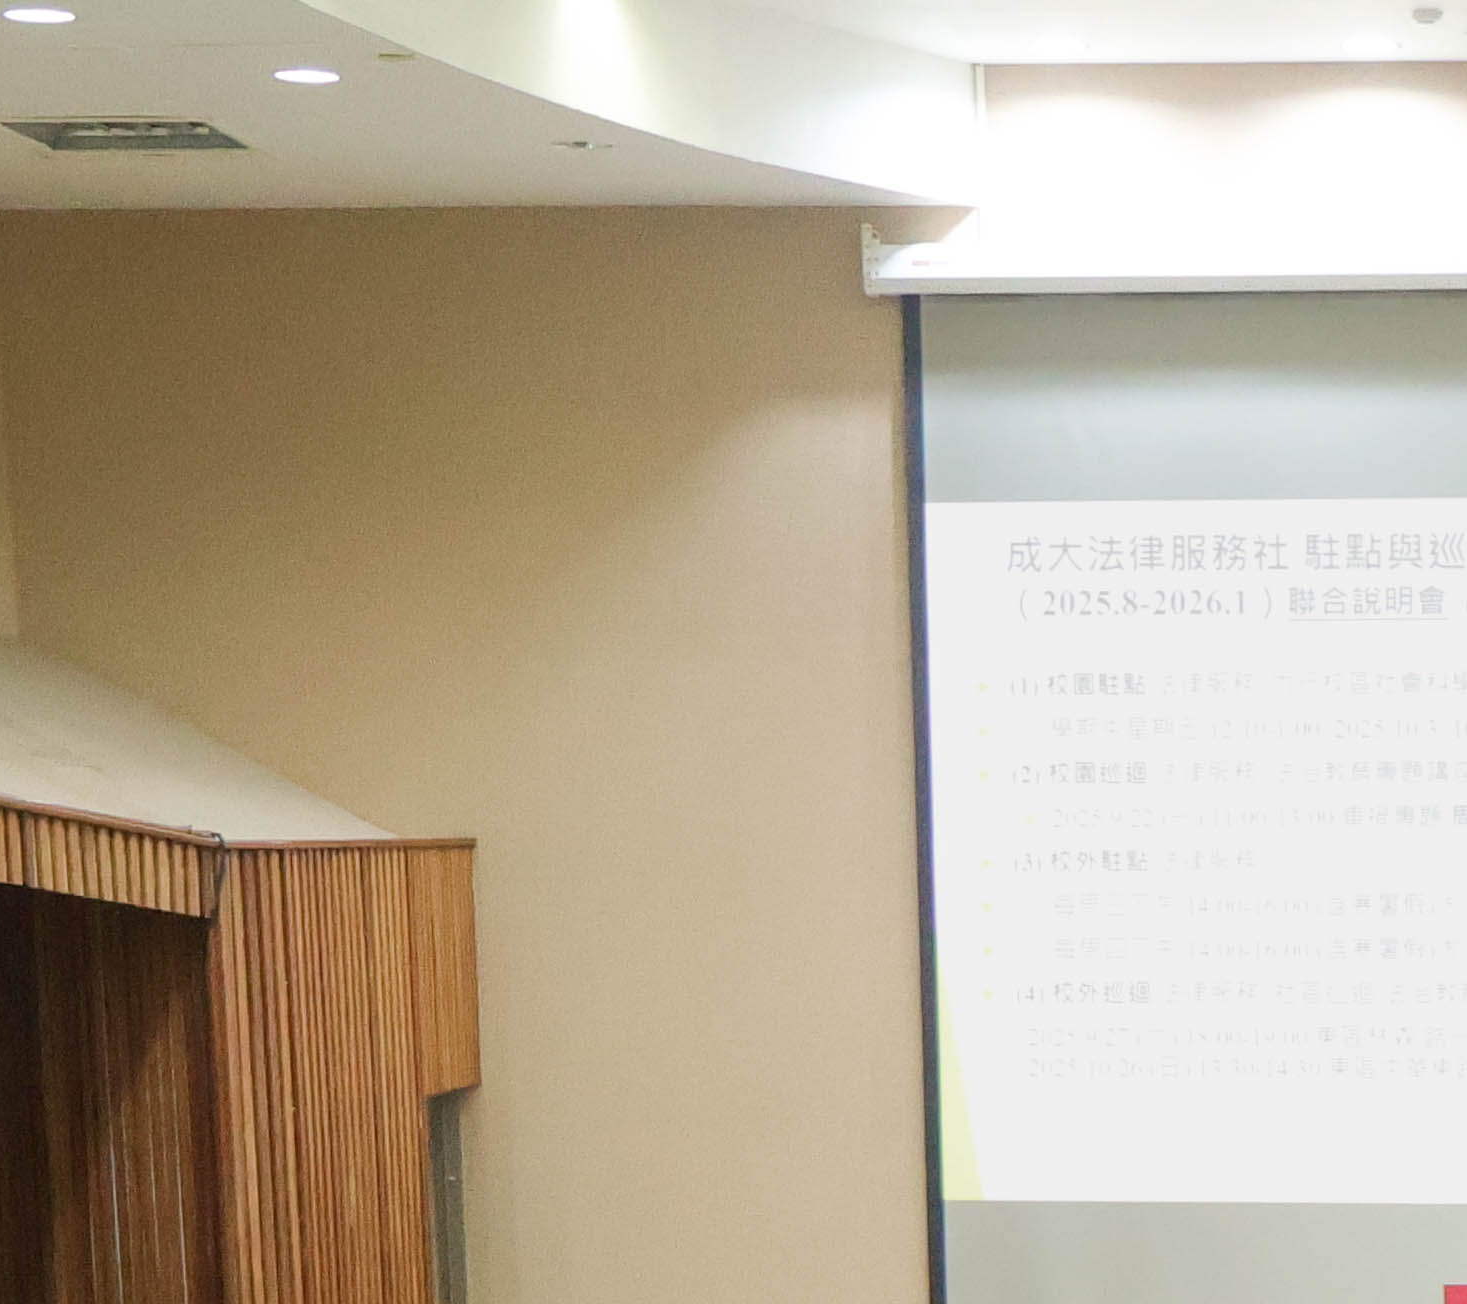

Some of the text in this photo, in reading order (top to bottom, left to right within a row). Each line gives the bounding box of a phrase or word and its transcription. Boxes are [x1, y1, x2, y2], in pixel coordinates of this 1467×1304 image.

[1007, 534, 1289, 572] 成大法律服務社
[1288, 585, 1447, 617] 聯合說明會
[1047, 671, 1147, 697] 校園駐點
